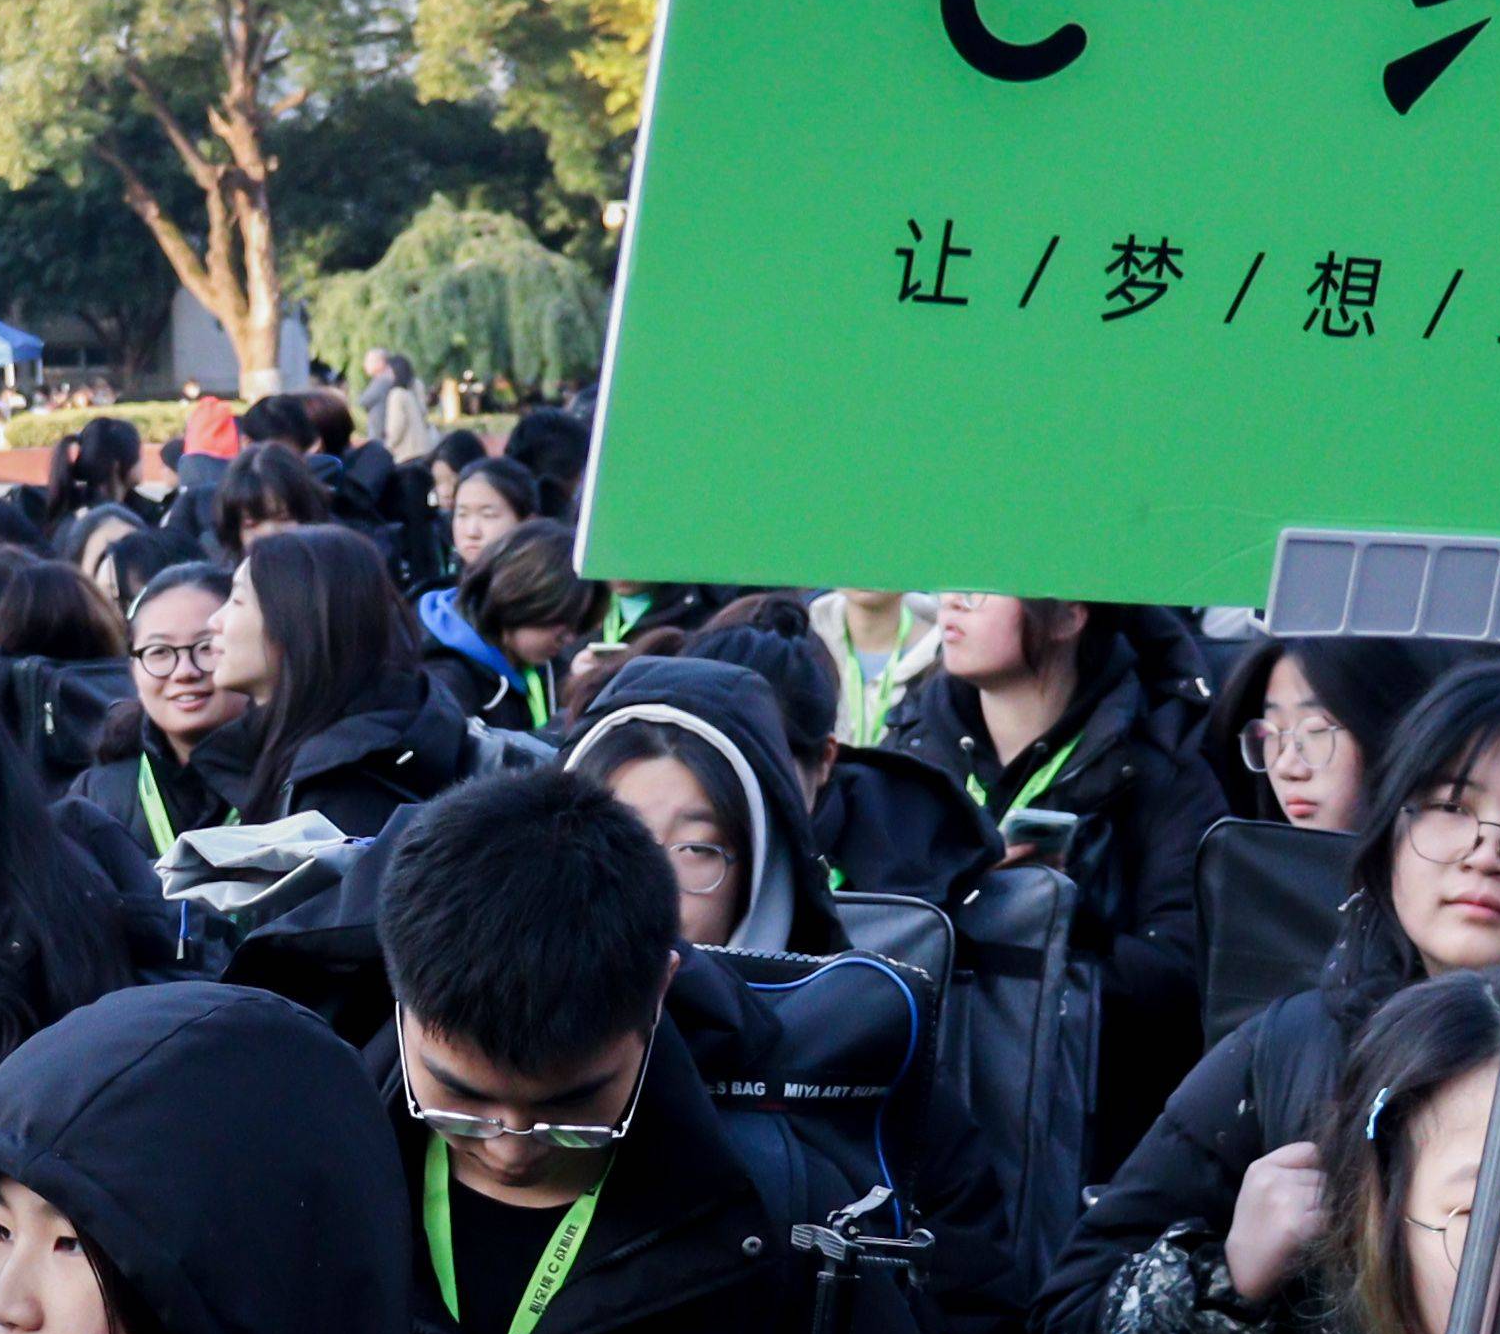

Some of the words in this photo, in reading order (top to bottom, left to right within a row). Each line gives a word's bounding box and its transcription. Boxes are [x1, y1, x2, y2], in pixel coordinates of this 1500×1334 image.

[731, 1081, 767, 1096] BAG
[783, 1082, 820, 1098] MIYA
[821, 1085, 852, 1098] ART
